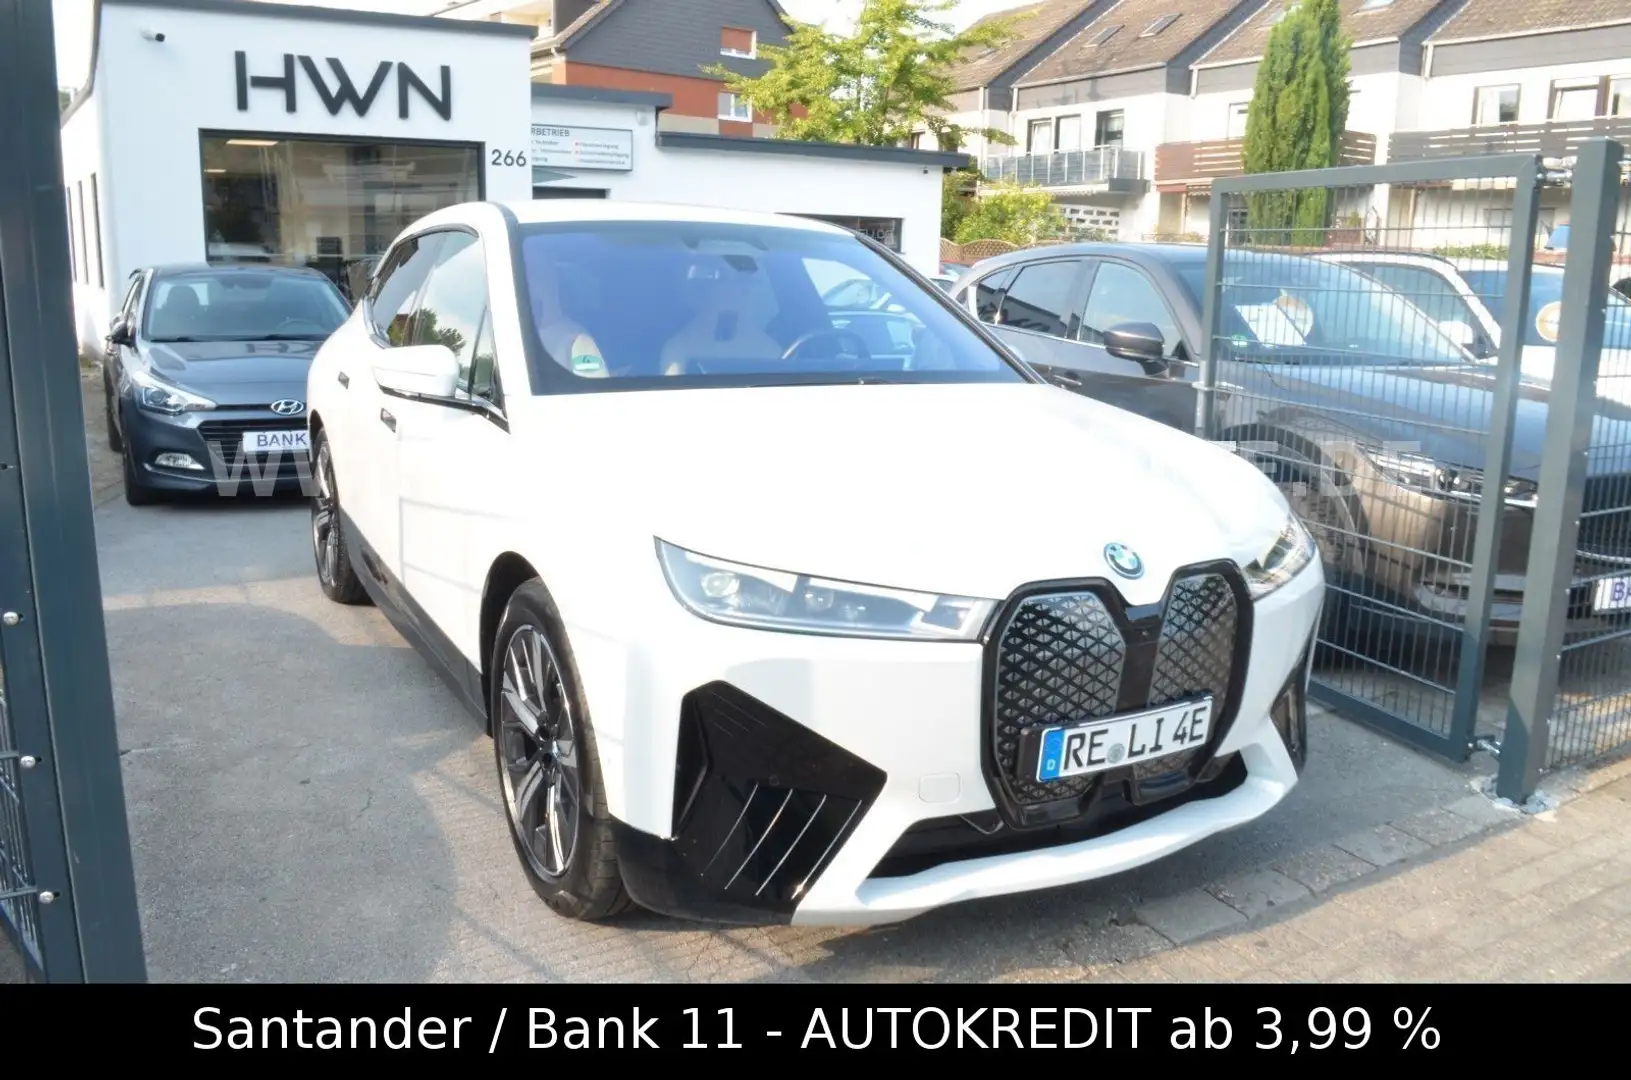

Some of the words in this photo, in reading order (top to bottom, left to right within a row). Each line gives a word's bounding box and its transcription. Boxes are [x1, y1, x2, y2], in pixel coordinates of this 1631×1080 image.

[235, 50, 451, 121] HWN
[491, 149, 527, 167] 266
[256, 432, 308, 448] BANK
[1063, 728, 1109, 771] RE
[1127, 716, 1165, 759] LI
[1172, 706, 1207, 745] 4E
